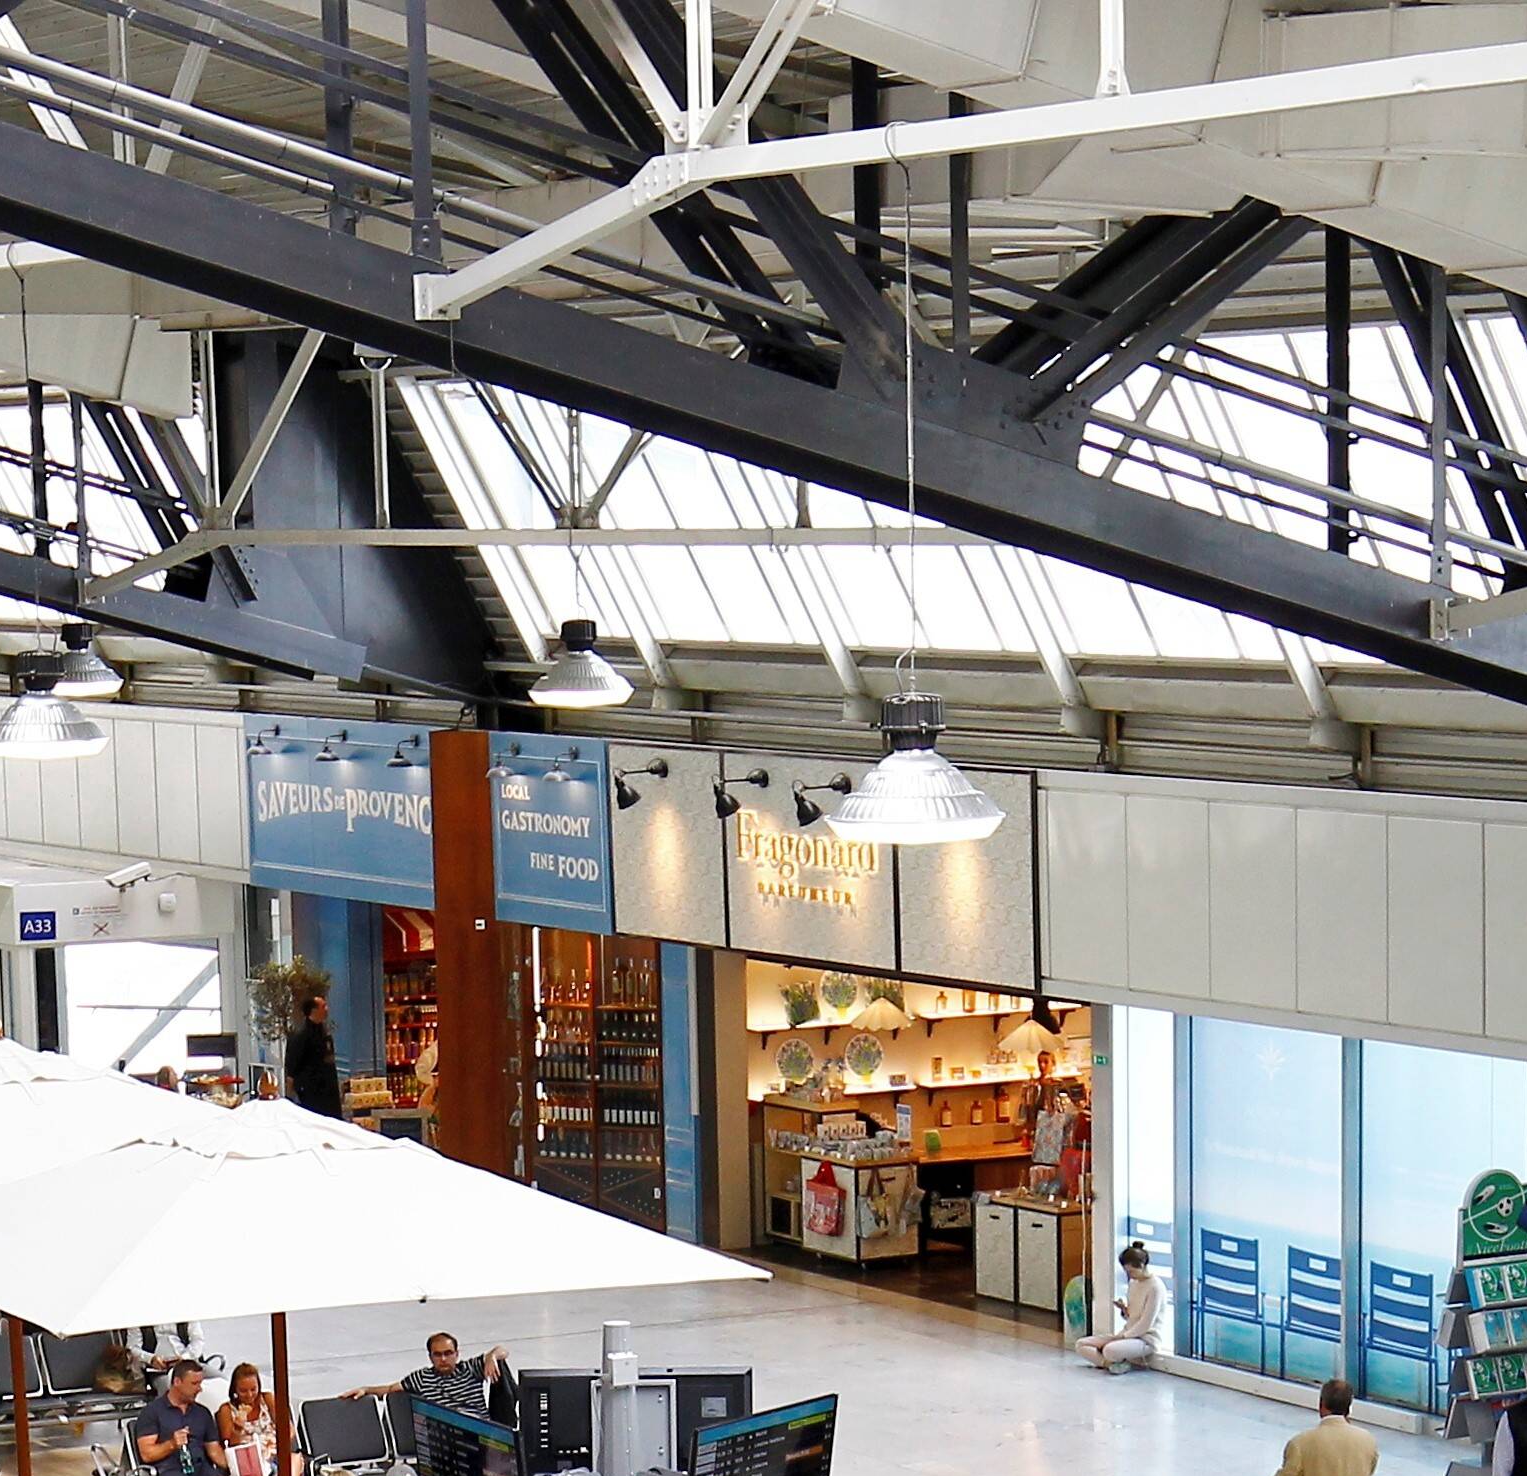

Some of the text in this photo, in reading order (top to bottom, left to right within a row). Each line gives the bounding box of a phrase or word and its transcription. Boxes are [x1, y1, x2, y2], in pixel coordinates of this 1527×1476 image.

[258, 781, 333, 823] SAVEURS
[501, 784, 530, 800] LOCAL
[502, 810, 591, 838] GASTRONOMY
[736, 809, 879, 879] Fragonard
[530, 851, 600, 882] FINE FOOD
[24, 920, 51, 933] A33
